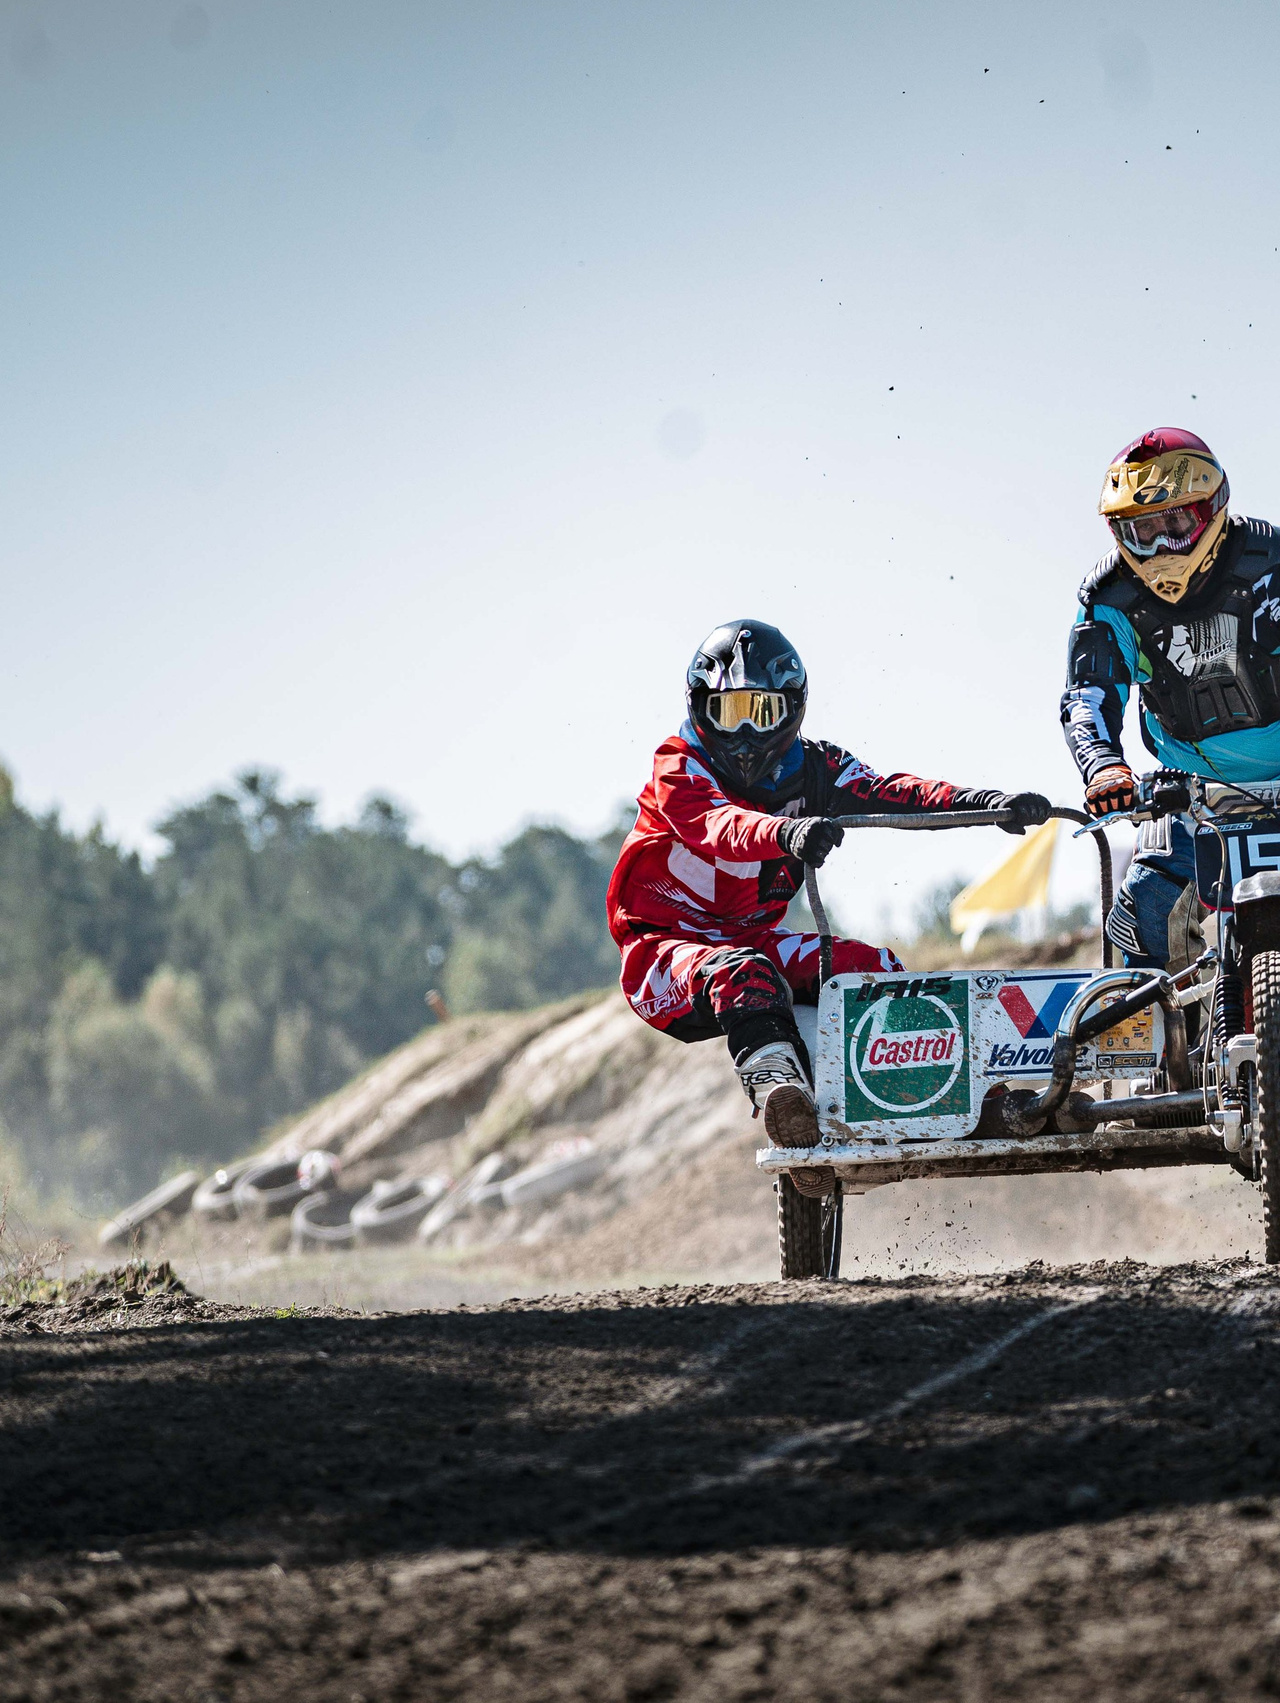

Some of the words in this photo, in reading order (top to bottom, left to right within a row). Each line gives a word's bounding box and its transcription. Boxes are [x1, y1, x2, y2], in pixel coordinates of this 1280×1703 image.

[868, 1032, 956, 1066] Castrol
[988, 1043, 1090, 1067] Valvole
[1114, 1056, 1153, 1066] SCOTT
[740, 1069, 797, 1086] TCX
